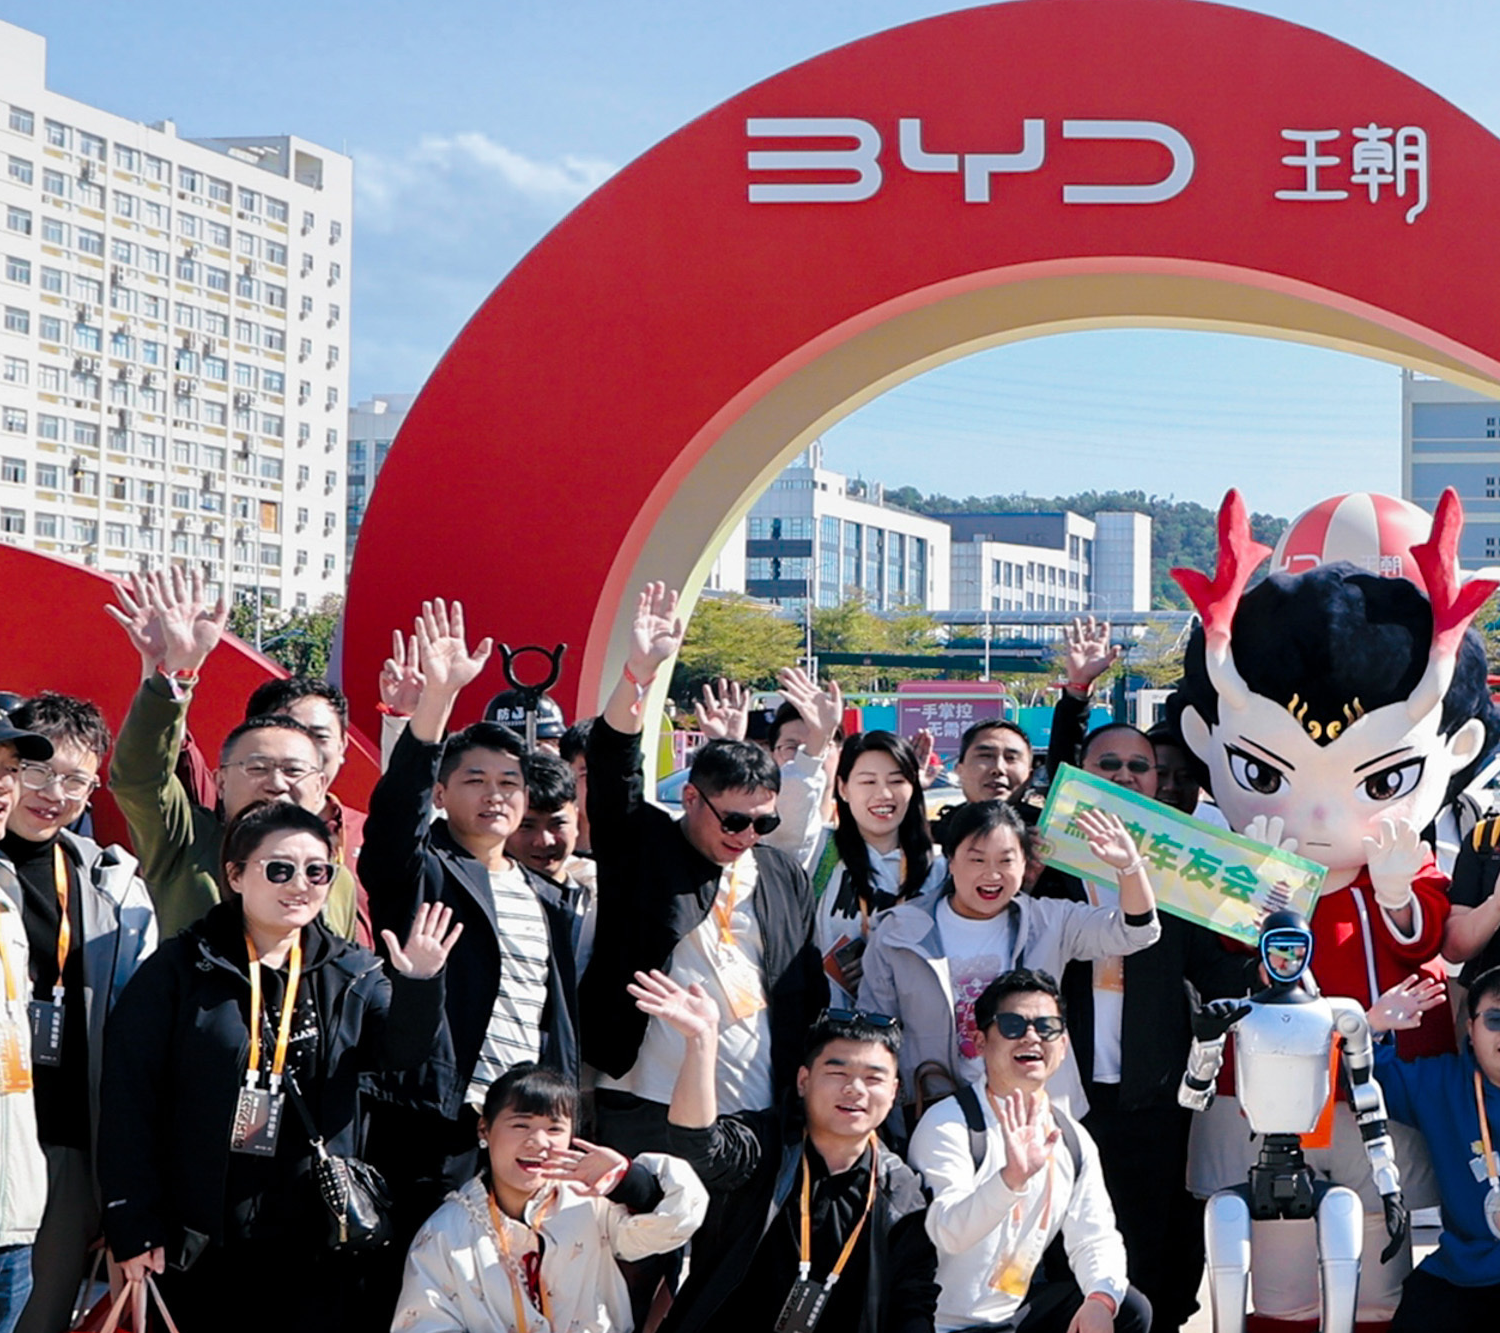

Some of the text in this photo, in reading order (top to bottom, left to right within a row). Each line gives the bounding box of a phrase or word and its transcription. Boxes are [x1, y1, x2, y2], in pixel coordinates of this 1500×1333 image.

[746, 117, 1430, 224] BYD 王朝
[905, 702, 973, 721] 一手掌控
